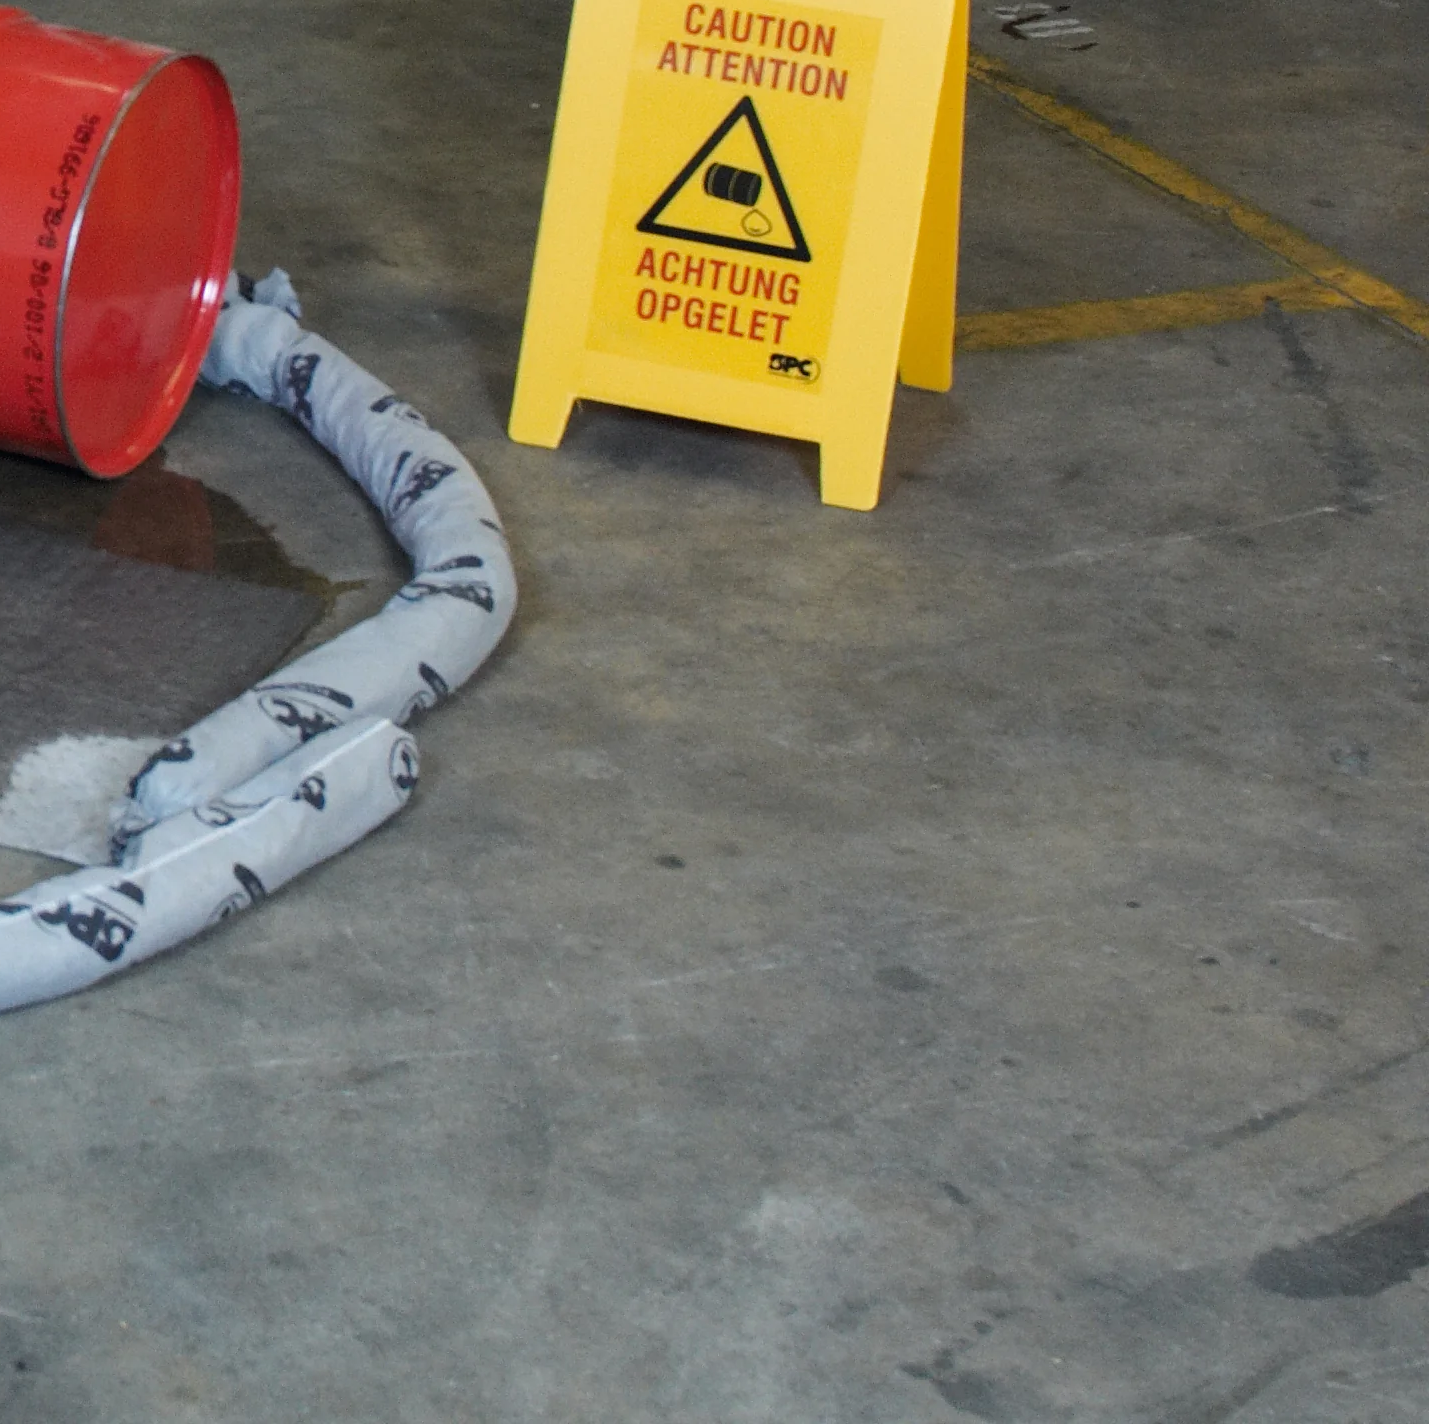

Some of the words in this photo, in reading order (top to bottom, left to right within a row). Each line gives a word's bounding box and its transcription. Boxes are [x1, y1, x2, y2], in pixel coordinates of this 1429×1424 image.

[684, 2, 836, 57] CAUTION
[657, 40, 849, 101] ATTENTION
[636, 247, 801, 305] ACHTUNG
[636, 288, 790, 344] OPGELET
[769, 353, 813, 377] SPC
